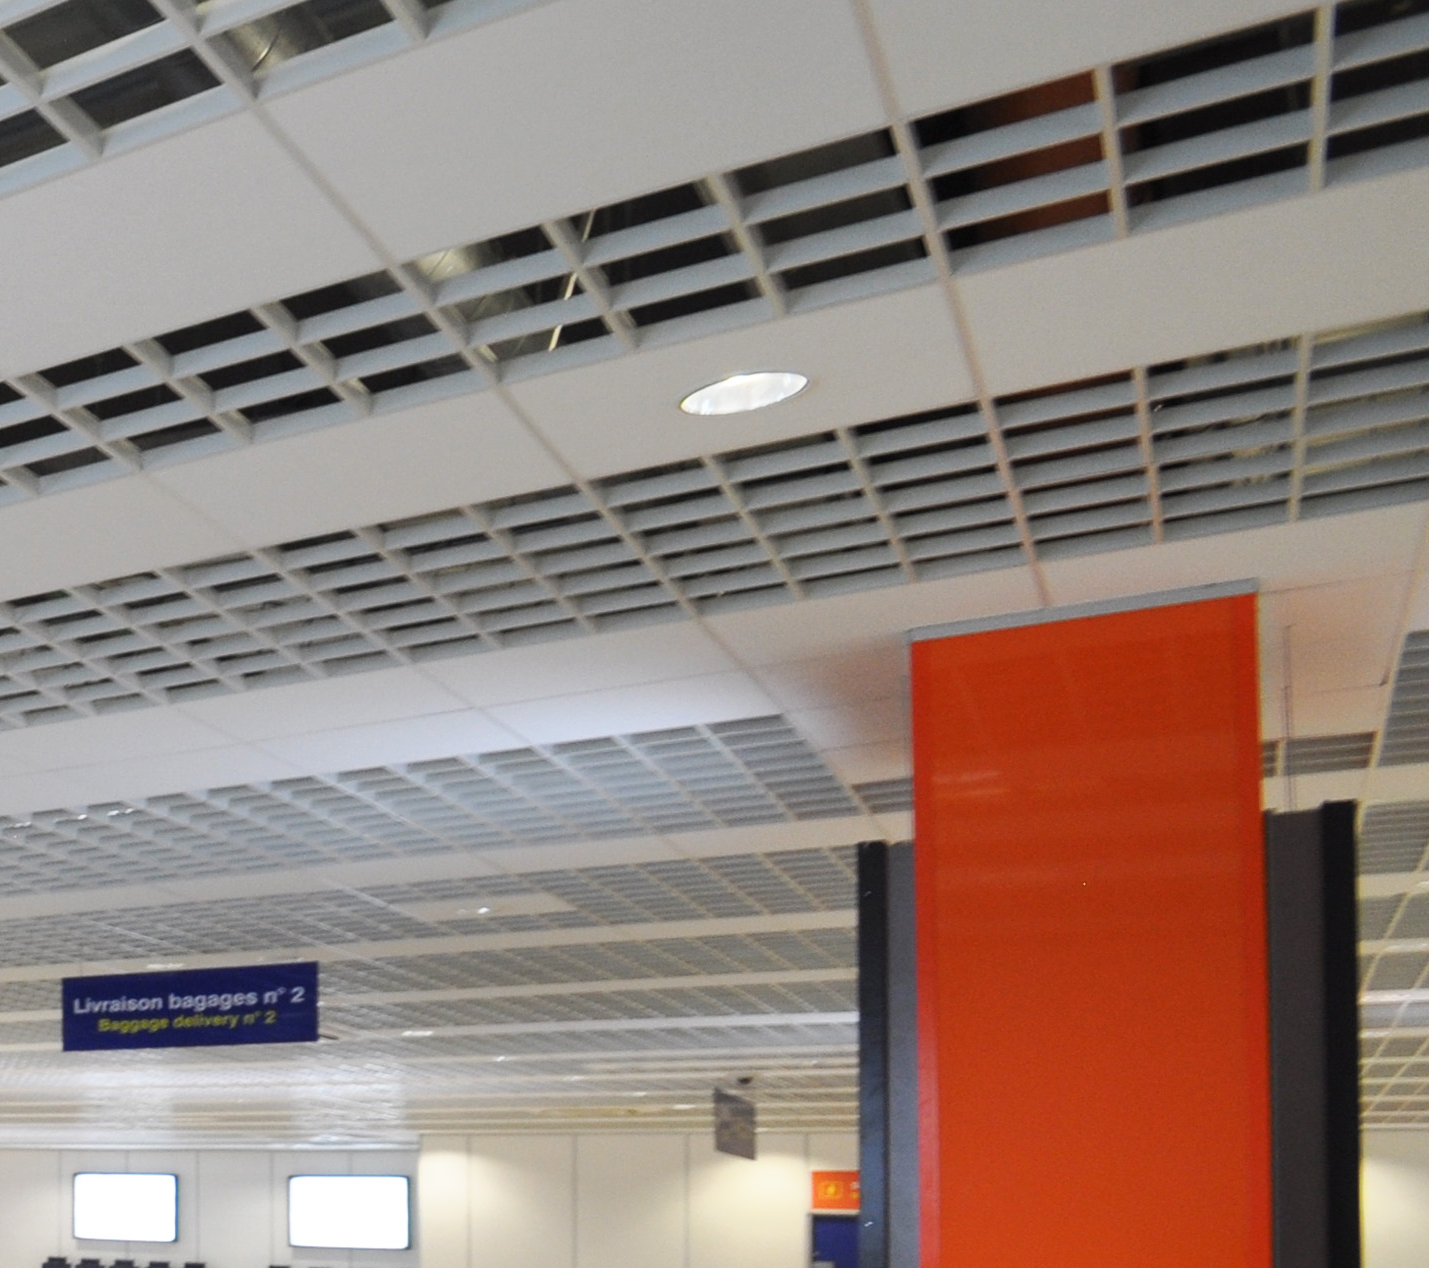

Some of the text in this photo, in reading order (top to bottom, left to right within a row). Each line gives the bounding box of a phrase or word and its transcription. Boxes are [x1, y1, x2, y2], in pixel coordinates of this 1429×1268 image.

[73, 996, 164, 1014] Livraison
[168, 991, 259, 1012] bagages
[290, 986, 306, 1003] 2
[98, 1018, 169, 1034] Baggage
[173, 1013, 240, 1029] delivery
[264, 1010, 277, 1024] 2
